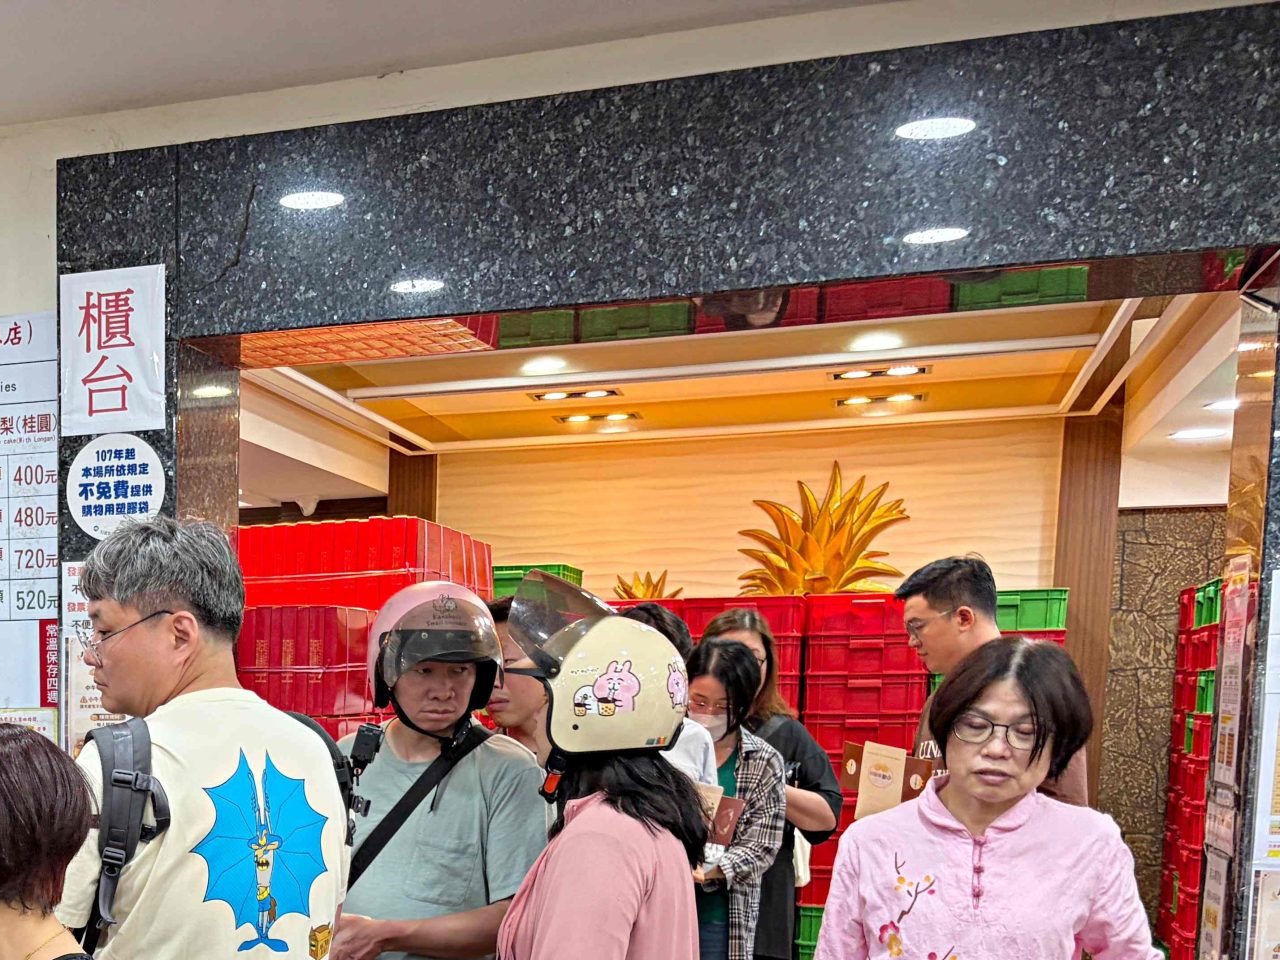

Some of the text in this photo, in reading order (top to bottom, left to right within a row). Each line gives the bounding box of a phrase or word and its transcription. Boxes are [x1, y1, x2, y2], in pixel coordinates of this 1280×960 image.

[78, 287, 134, 417] 櫃台
[95, 448, 136, 462] 107年起
[13, 464, 57, 486] 400元
[81, 463, 150, 479] 本場所依規定
[78, 480, 153, 501] 不免費提供
[14, 506, 58, 528] 480元
[15, 548, 58, 569] 720元
[16, 590, 58, 611] 520元
